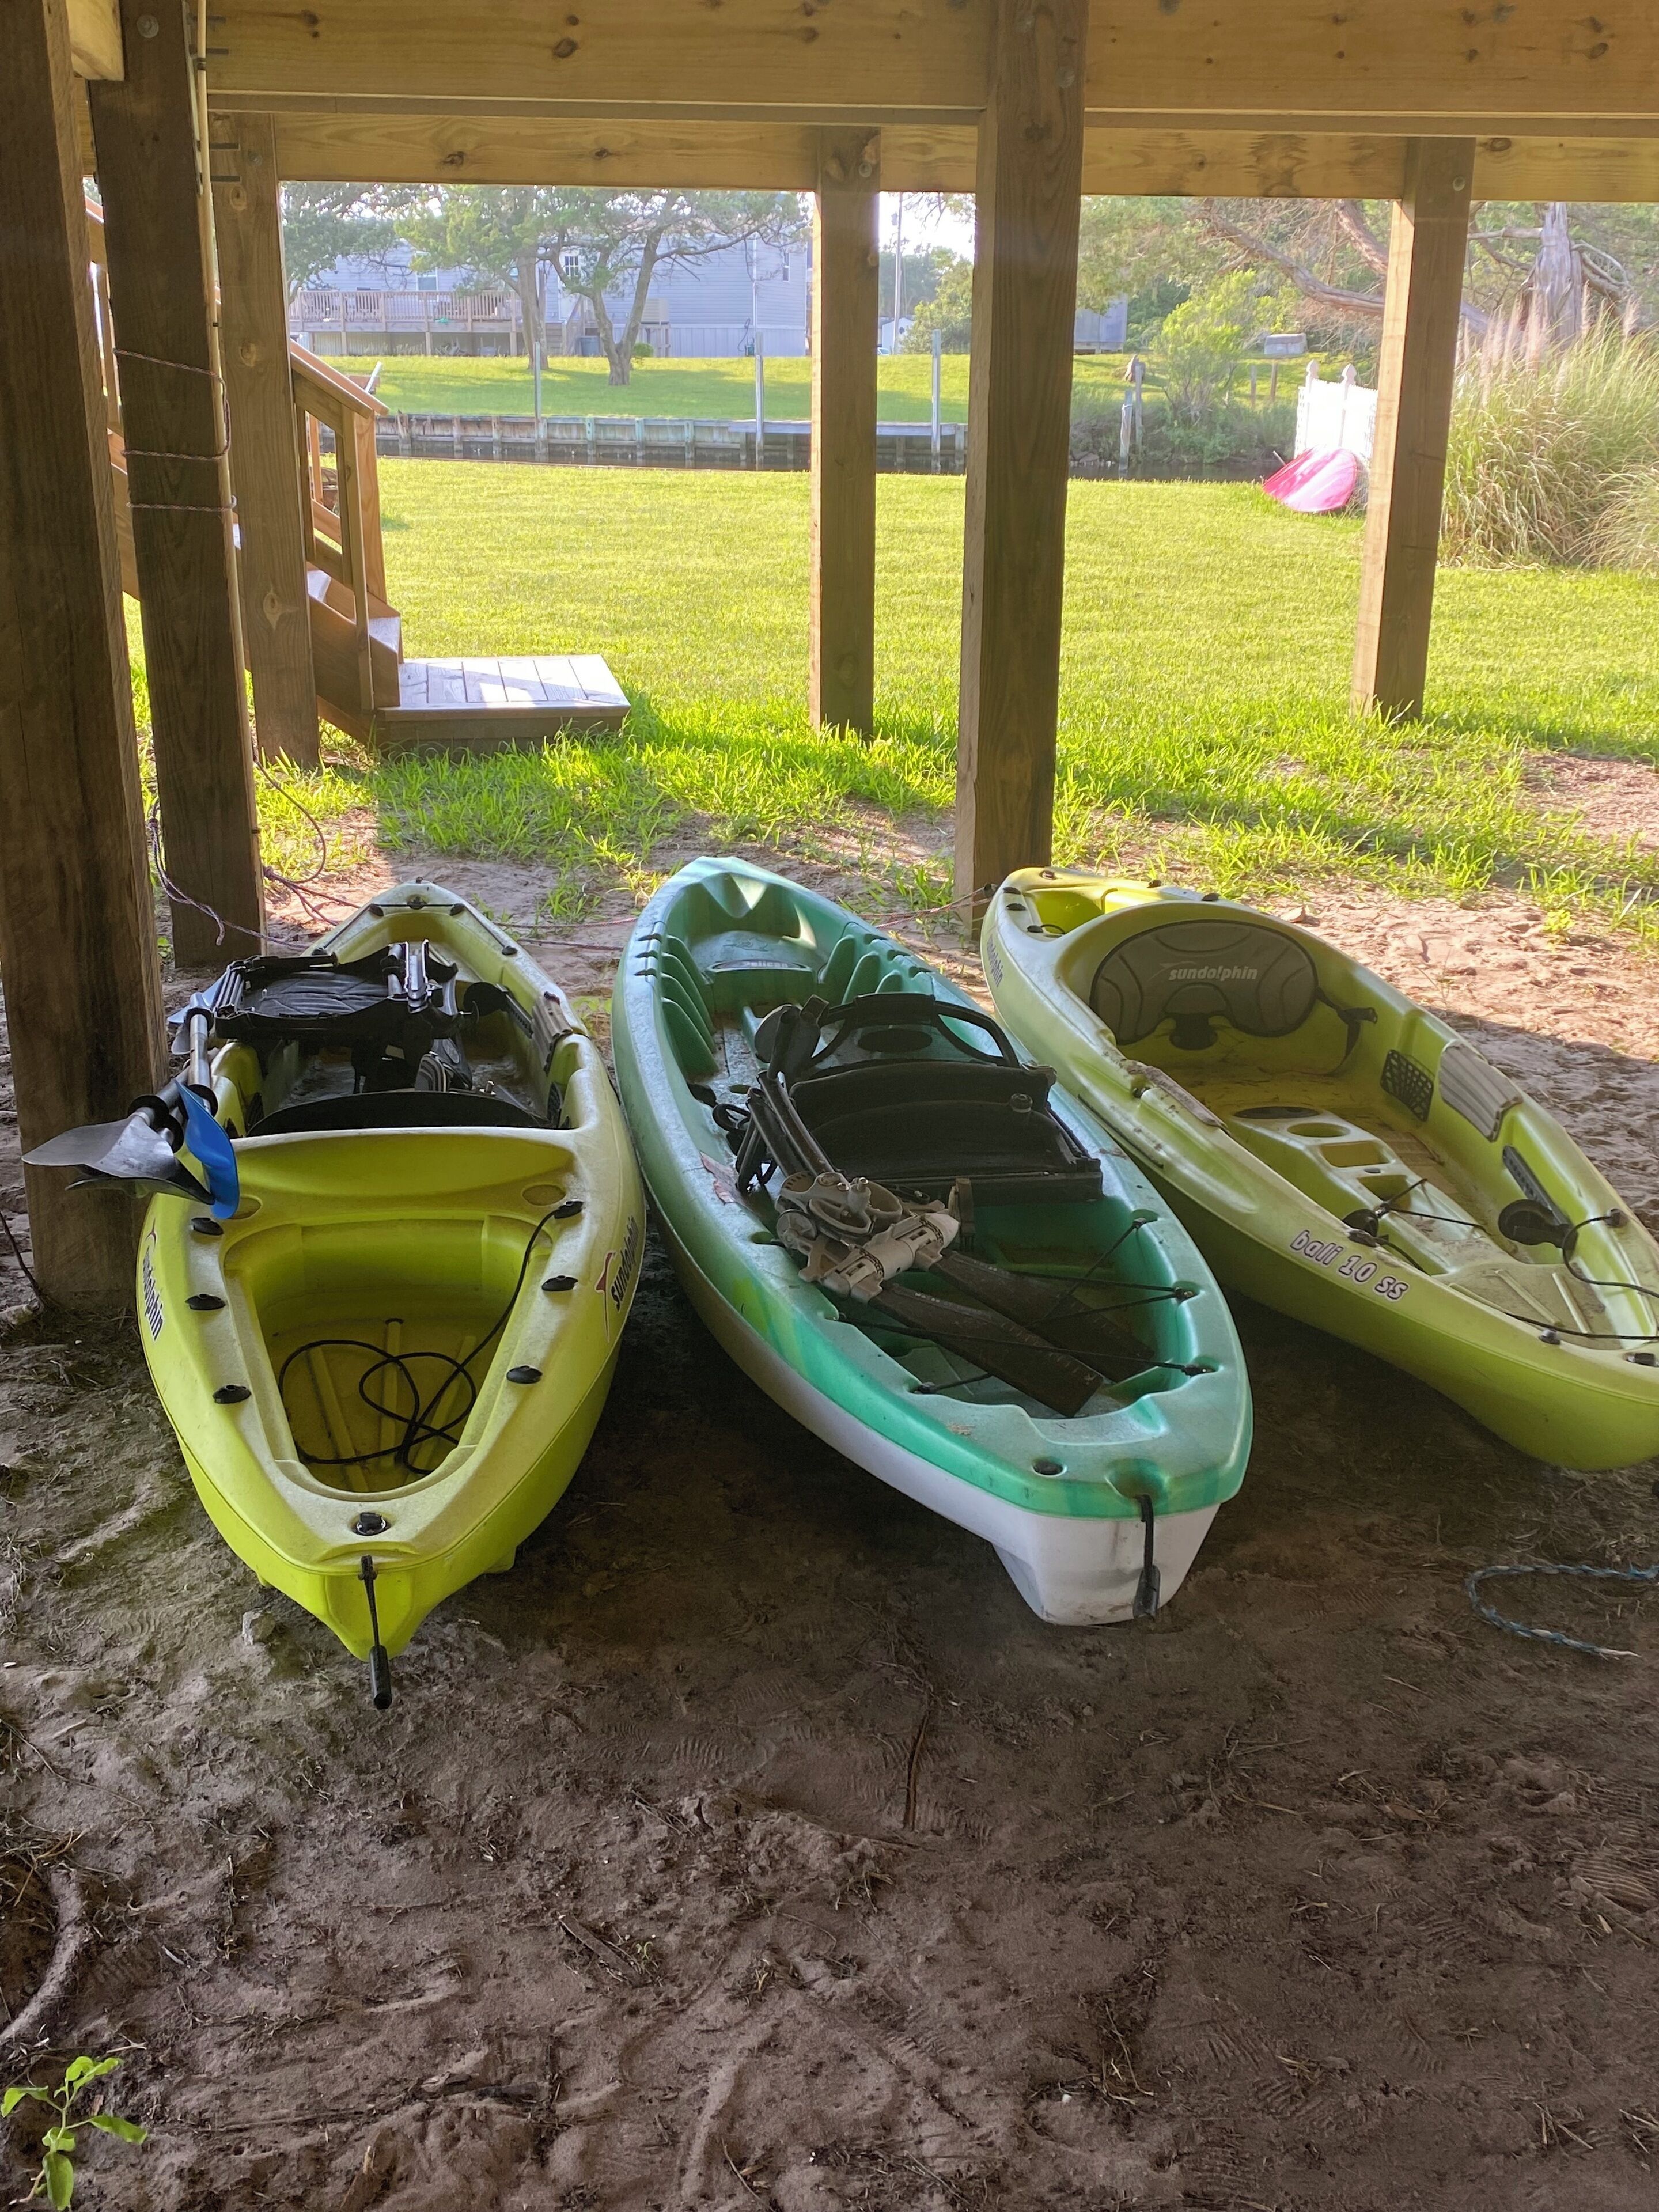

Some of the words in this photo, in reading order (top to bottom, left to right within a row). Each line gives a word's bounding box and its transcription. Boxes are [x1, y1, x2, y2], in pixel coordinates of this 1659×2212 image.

[1168, 965, 1258, 982] sundolphin
[143, 1245, 163, 1341] dolphin
[611, 1215, 639, 1312] sundolphin
[1290, 1229, 1344, 1266] bali
[1338, 1255, 1378, 1283] 10
[1374, 1275, 1409, 1300] ss
